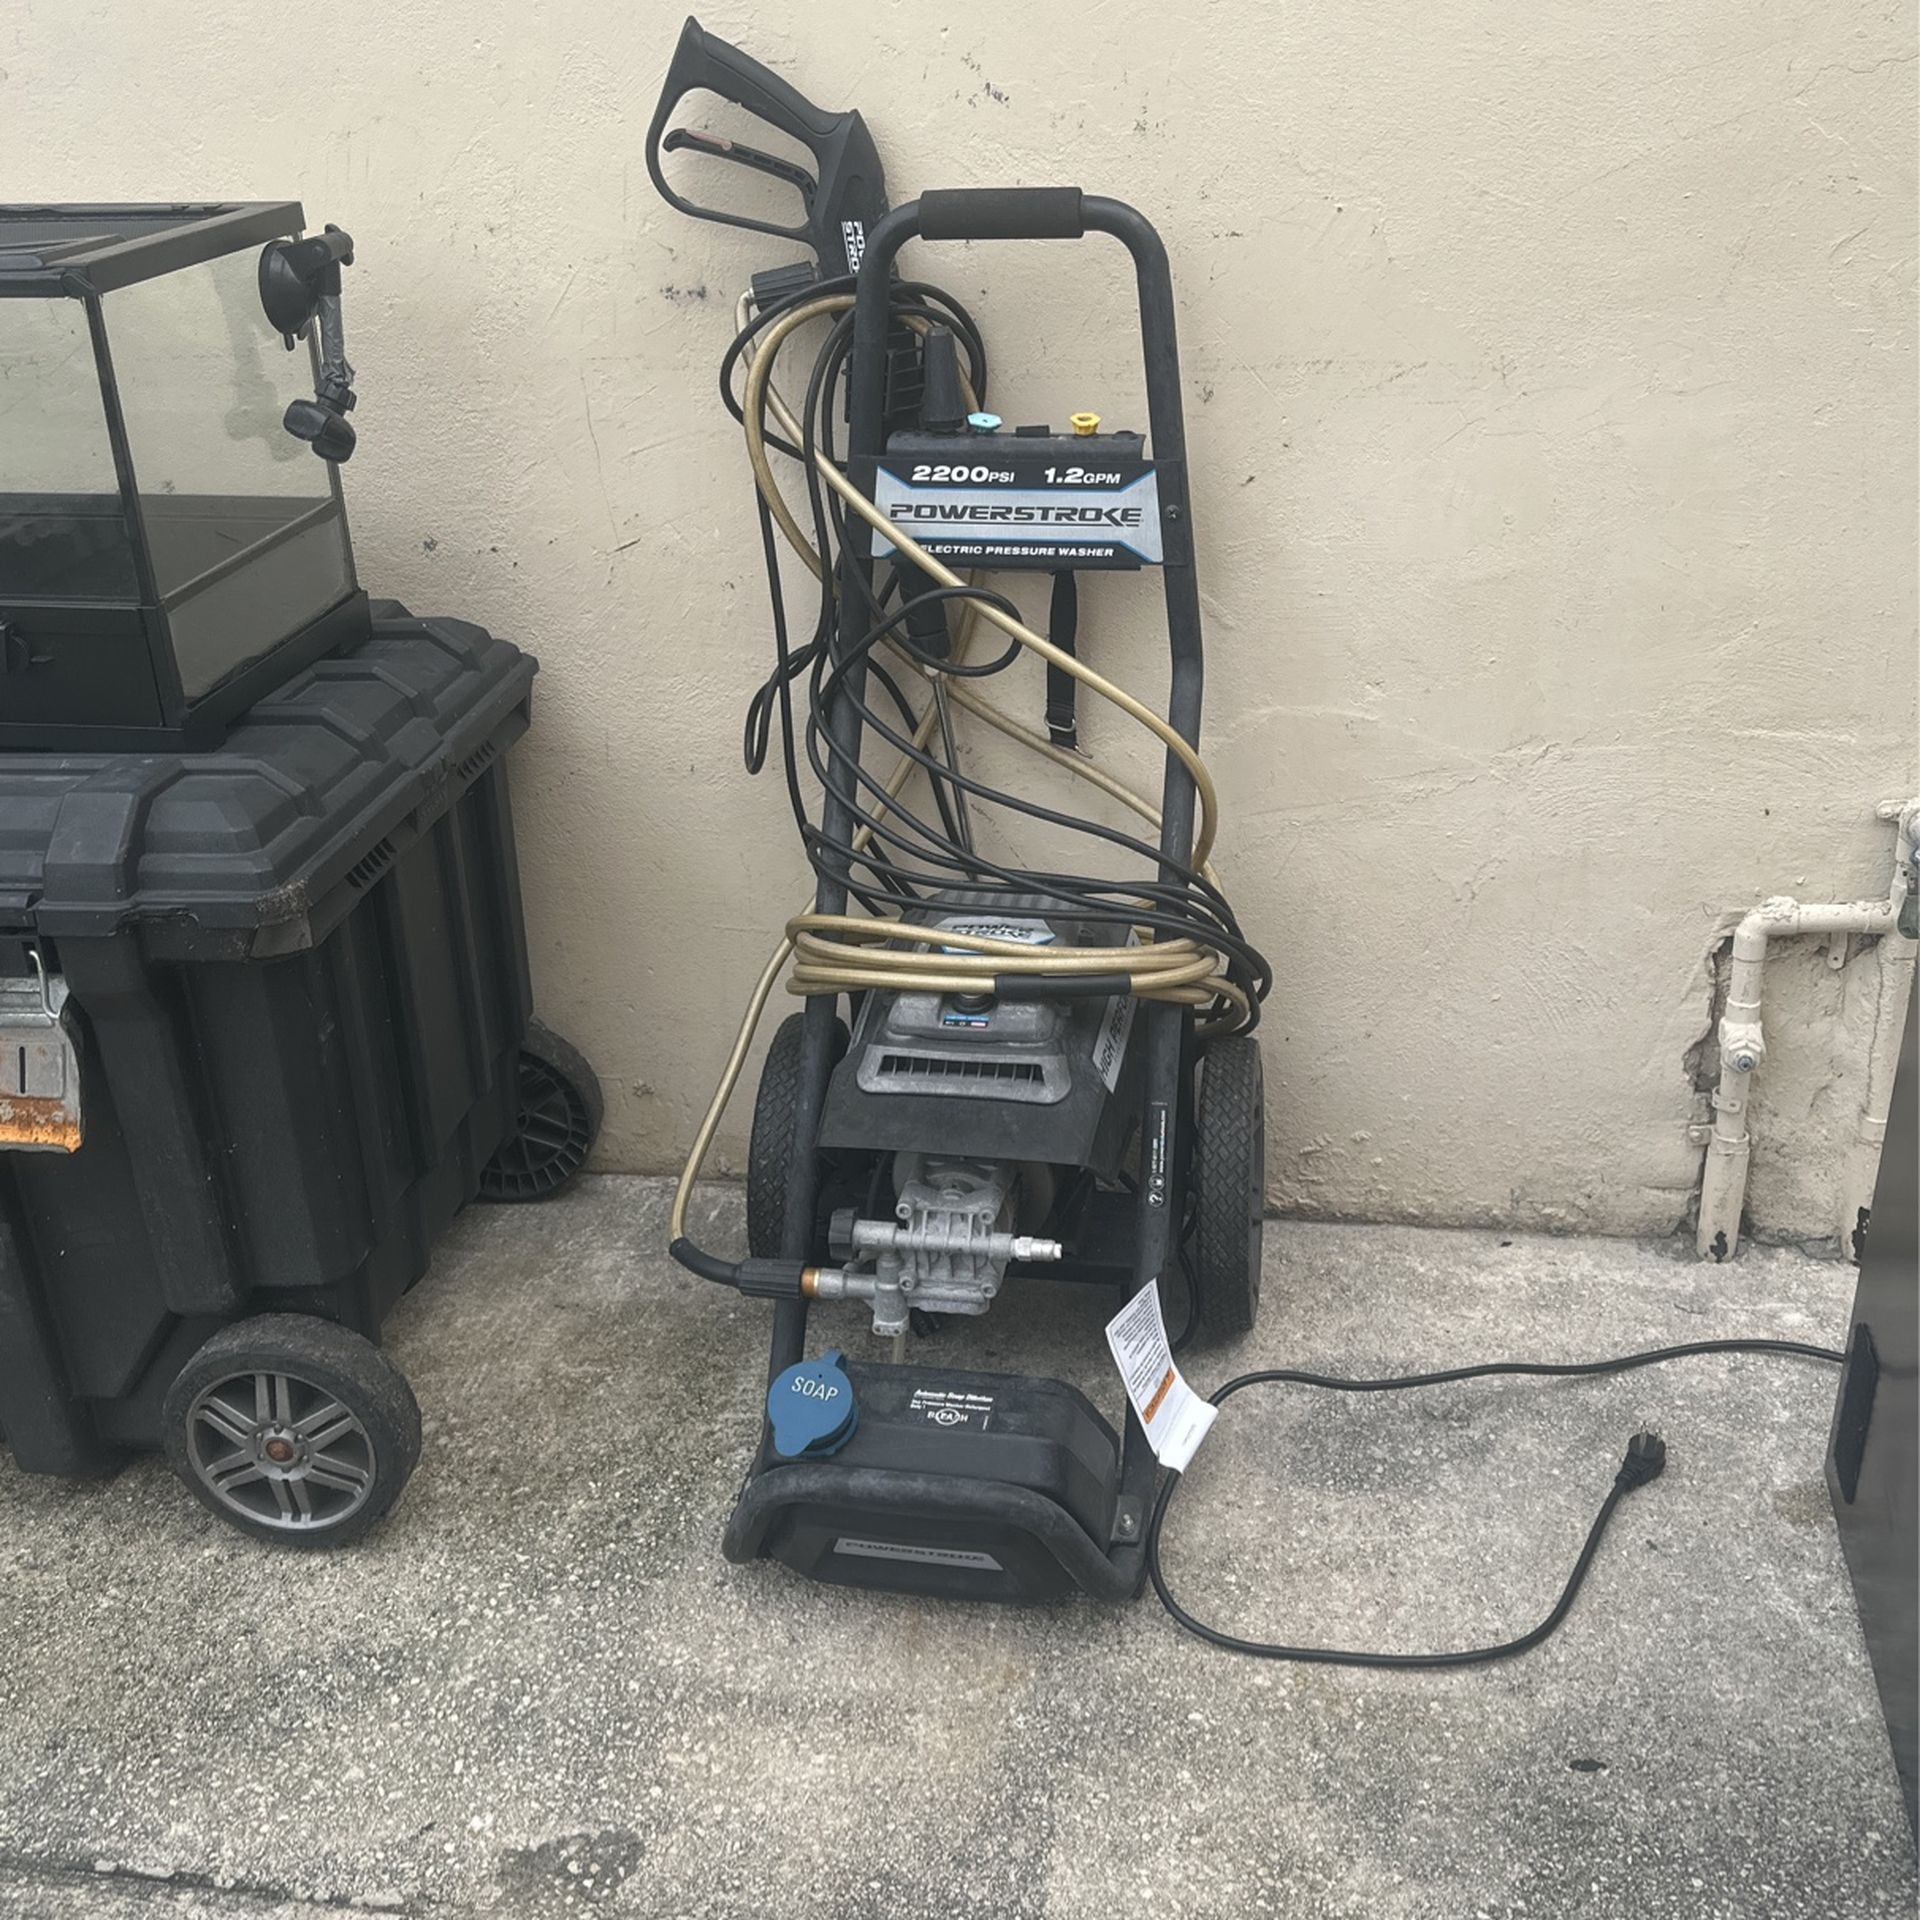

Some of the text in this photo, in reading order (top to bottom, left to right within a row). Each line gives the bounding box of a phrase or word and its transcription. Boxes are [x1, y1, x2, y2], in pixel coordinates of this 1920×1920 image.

[890, 504, 1142, 527] POWERSTROKE
[985, 545, 1056, 556] PRESSURE
[1058, 547, 1114, 557] WASHER
[791, 1376, 838, 1401] SOAP
